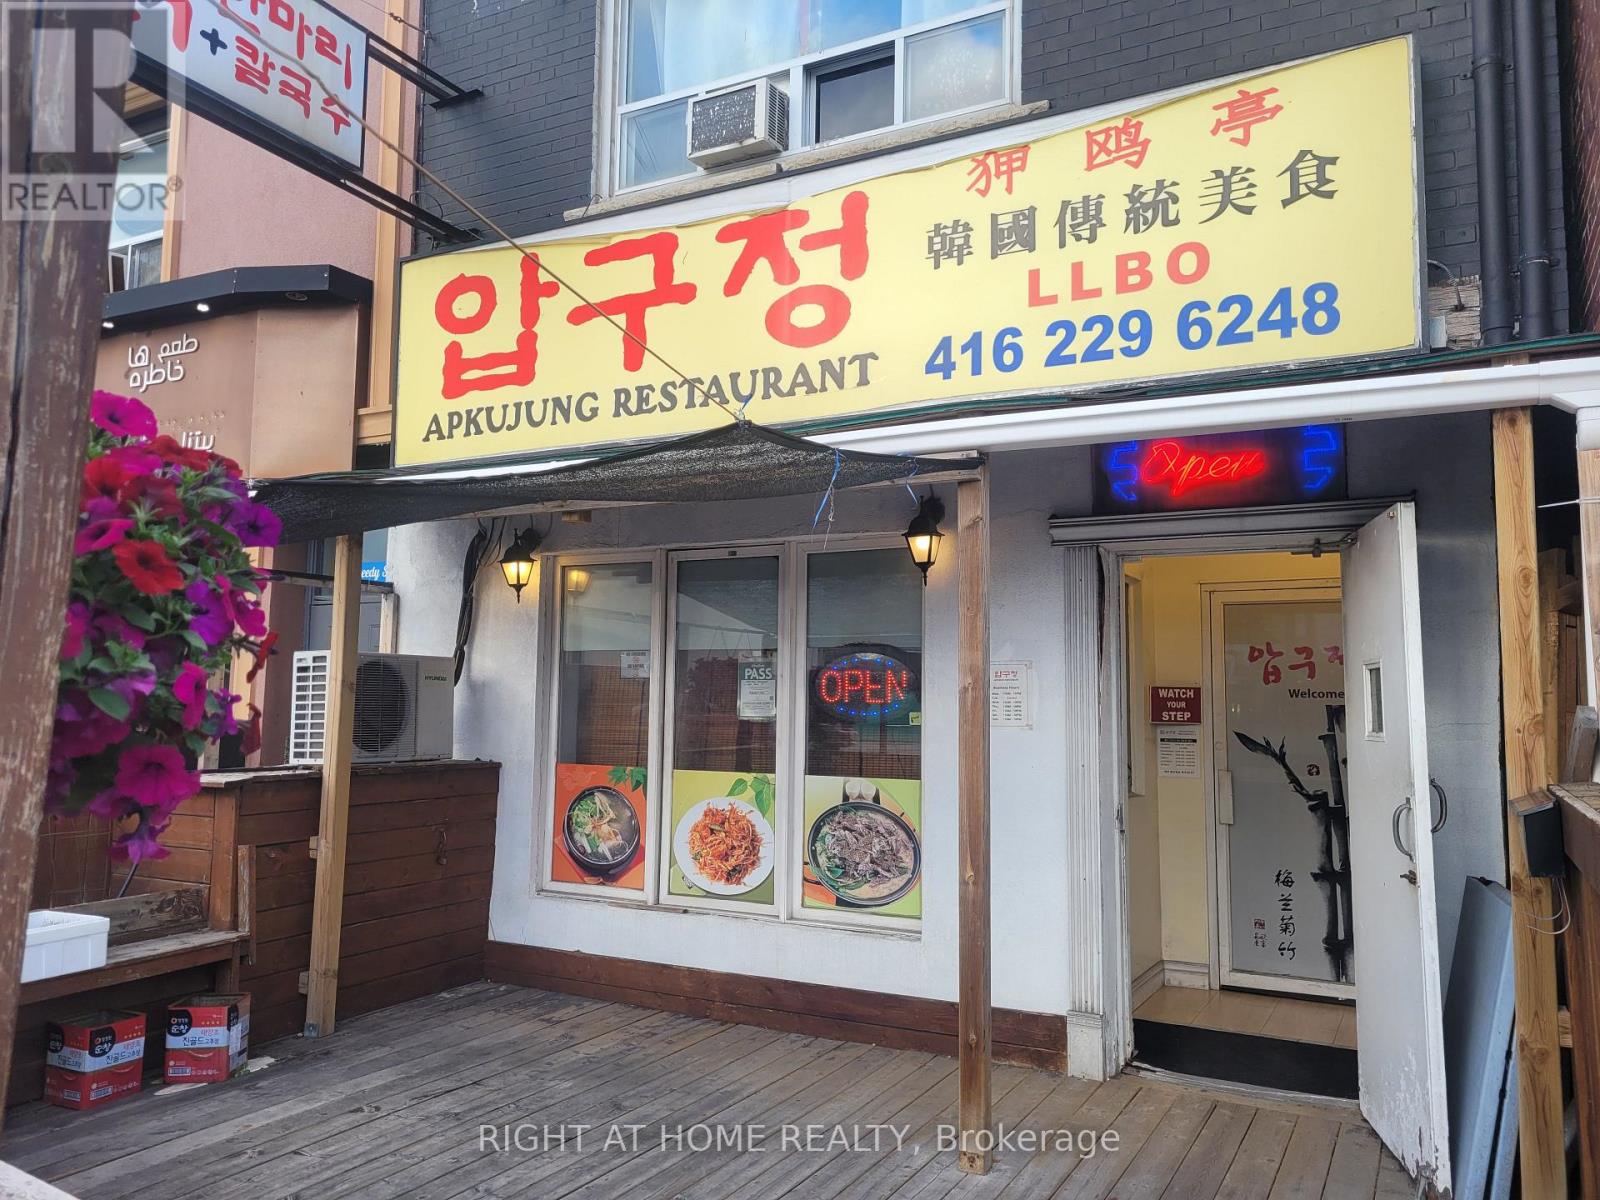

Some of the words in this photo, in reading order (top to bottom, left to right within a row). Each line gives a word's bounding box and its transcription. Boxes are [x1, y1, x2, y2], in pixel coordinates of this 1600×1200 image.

[925, 149, 1340, 271] 韓國傳統美食
[435, 191, 869, 400] 압구정
[1027, 241, 1211, 307] LLBO
[924, 327, 1024, 381] 416
[1044, 309, 1153, 368] 229
[1177, 282, 1341, 351] 6248
[422, 391, 599, 442] APKUJUNG
[612, 352, 880, 418] RESTAURANT
[1142, 440, 1265, 497] Open
[744, 667, 772, 680] PASS
[819, 669, 909, 703] OPEN
[1158, 688, 1194, 699] WATCH
[1288, 688, 1345, 699] Welcome
[1162, 711, 1192, 721] STEP
[1166, 701, 1186, 709] YOUR
